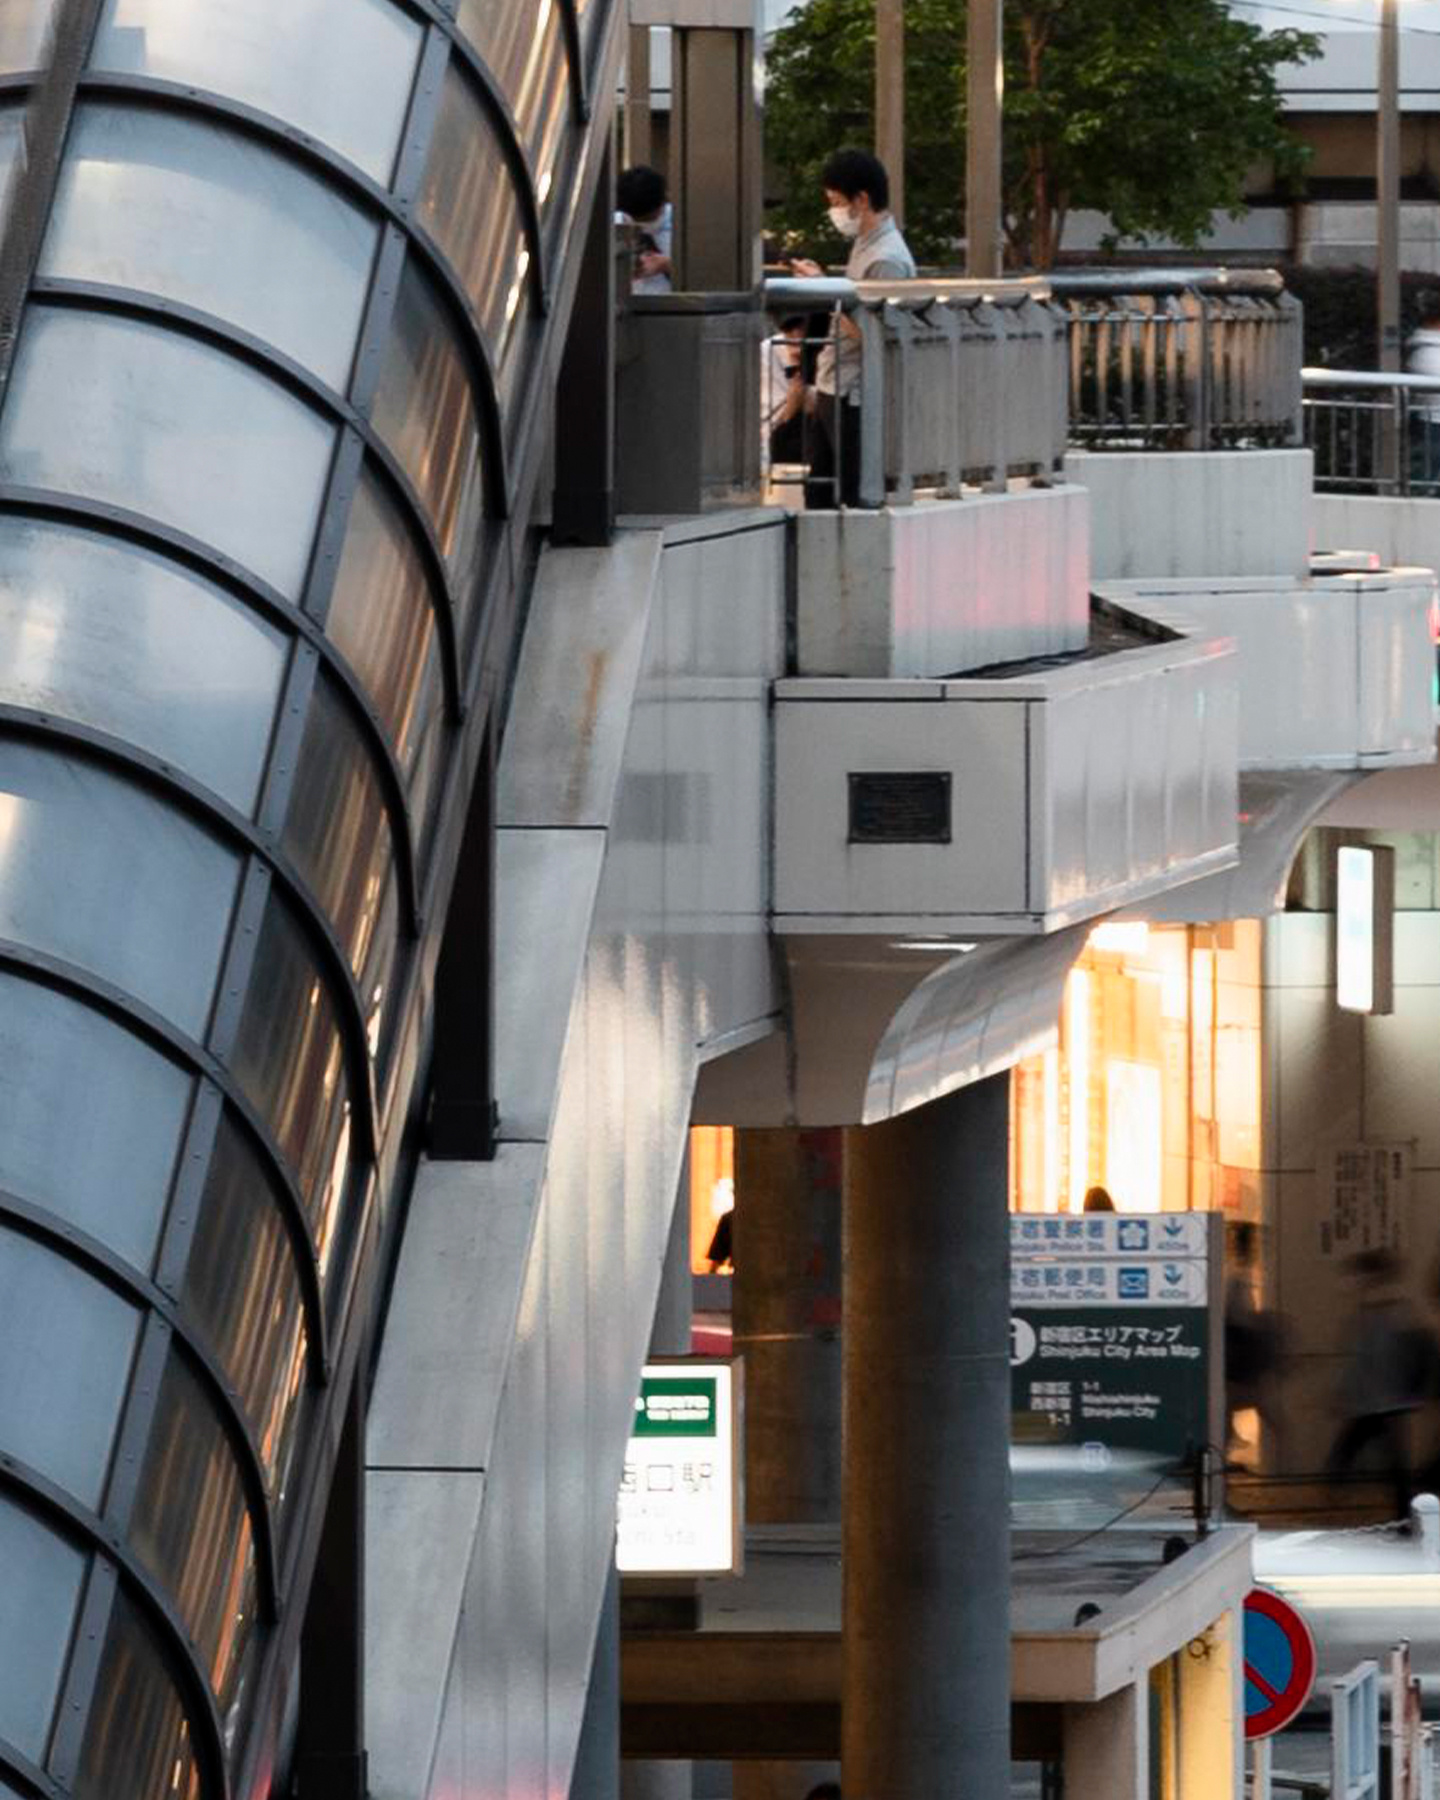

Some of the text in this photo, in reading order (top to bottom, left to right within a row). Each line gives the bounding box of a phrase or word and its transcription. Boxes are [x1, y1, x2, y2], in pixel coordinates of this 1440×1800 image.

[1103, 1344, 1131, 1360] City
[1134, 1344, 1167, 1358] Area
[1171, 1344, 1201, 1360] Map
